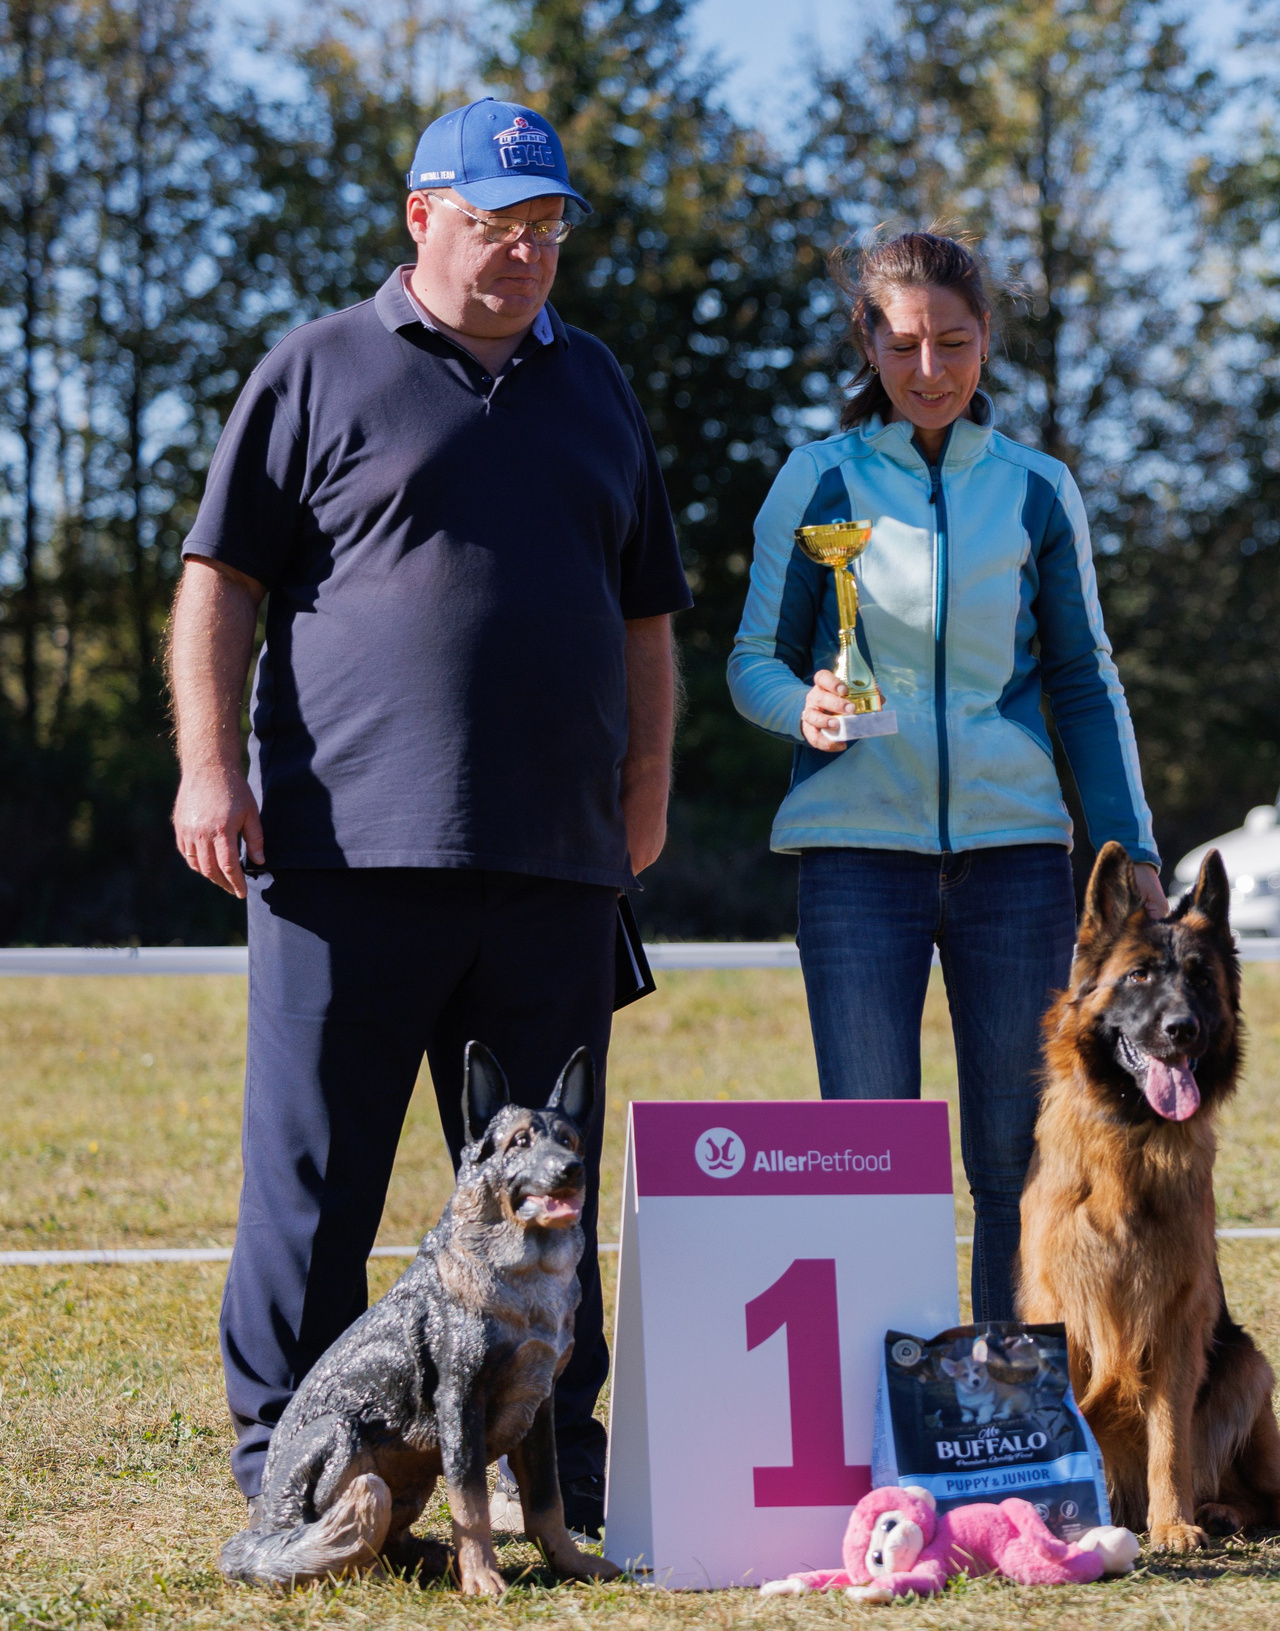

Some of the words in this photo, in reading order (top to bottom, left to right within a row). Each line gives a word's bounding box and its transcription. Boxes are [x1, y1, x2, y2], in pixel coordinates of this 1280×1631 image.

[500, 144, 555, 169] 1946
[440, 170, 456, 180] TEAM
[752, 1149, 891, 1173] AllerPetfood
[745, 1258, 872, 1507] 1
[936, 1431, 1048, 1460] BUFFALO
[946, 1476, 989, 1492] PUPPY
[992, 1478, 1000, 1486] &
[1002, 1469, 1050, 1486] JUNIOR
